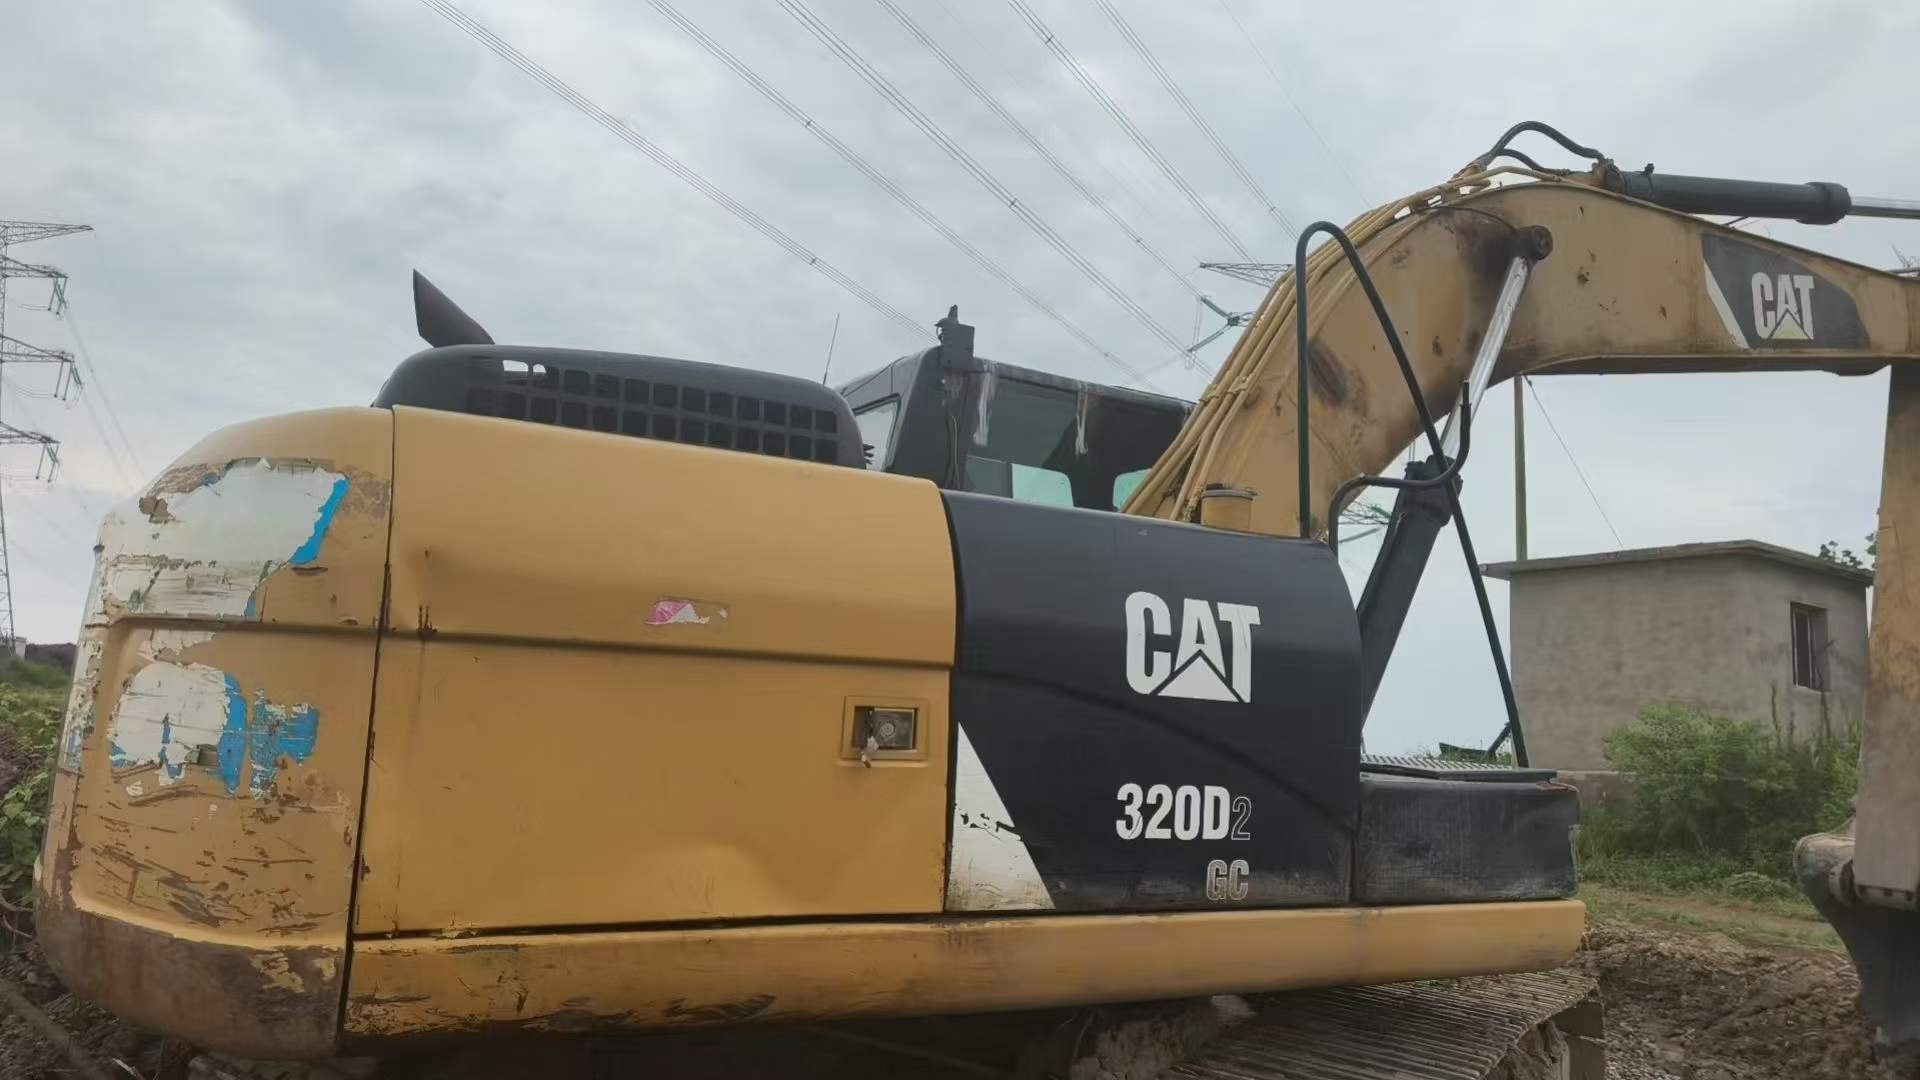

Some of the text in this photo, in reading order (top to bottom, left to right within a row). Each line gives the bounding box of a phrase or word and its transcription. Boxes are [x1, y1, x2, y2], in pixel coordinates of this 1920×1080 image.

[1751, 271, 1815, 340] CAT
[1125, 591, 1261, 703] CAT
[1116, 783, 1251, 841] 320D2
[1206, 859, 1249, 900] GC
